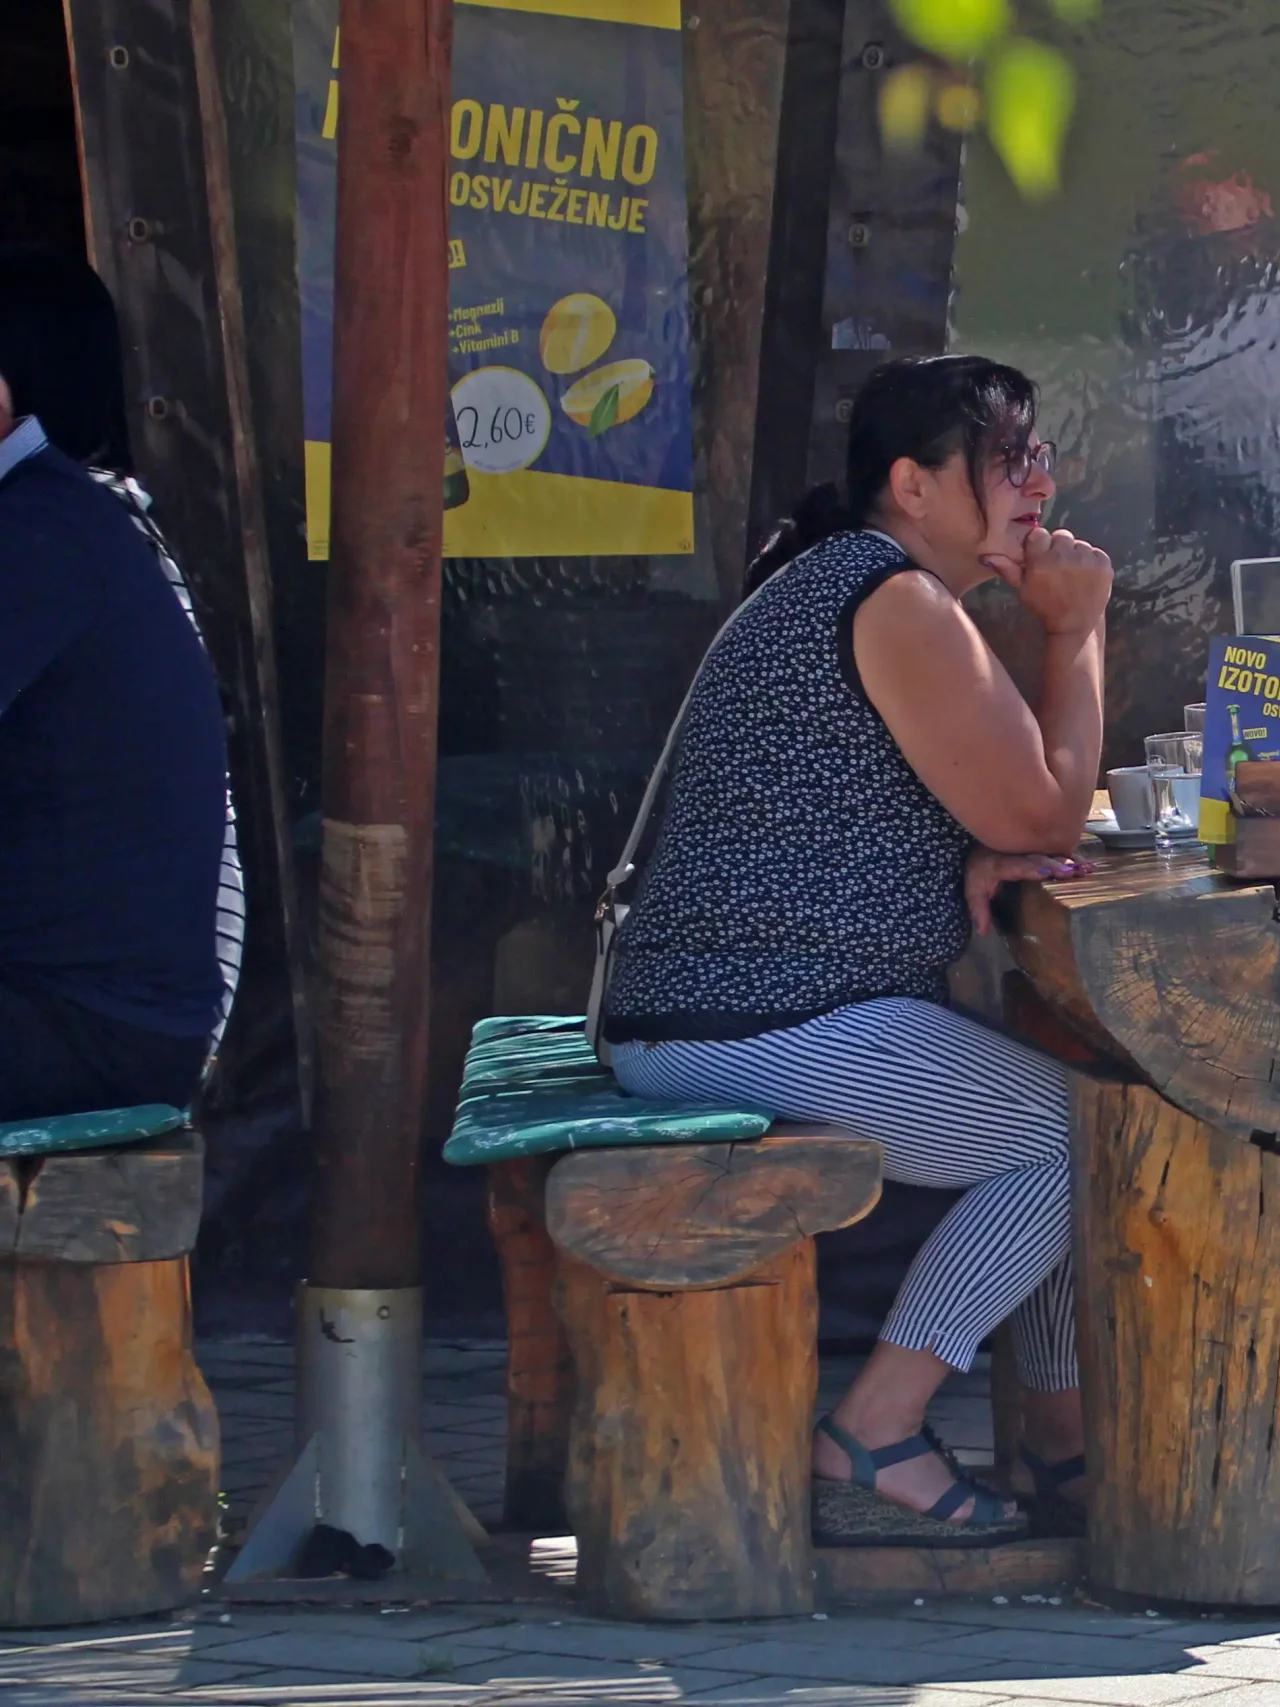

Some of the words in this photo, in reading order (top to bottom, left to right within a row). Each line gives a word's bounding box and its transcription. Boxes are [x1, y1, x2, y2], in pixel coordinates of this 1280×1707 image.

[450, 171, 649, 233] OSVJEŽENJE
[511, 329, 519, 343] B
[456, 406, 535, 448] 2,60€
[1224, 646, 1266, 669] NOVO
[1244, 729, 1266, 739] NOVO!
